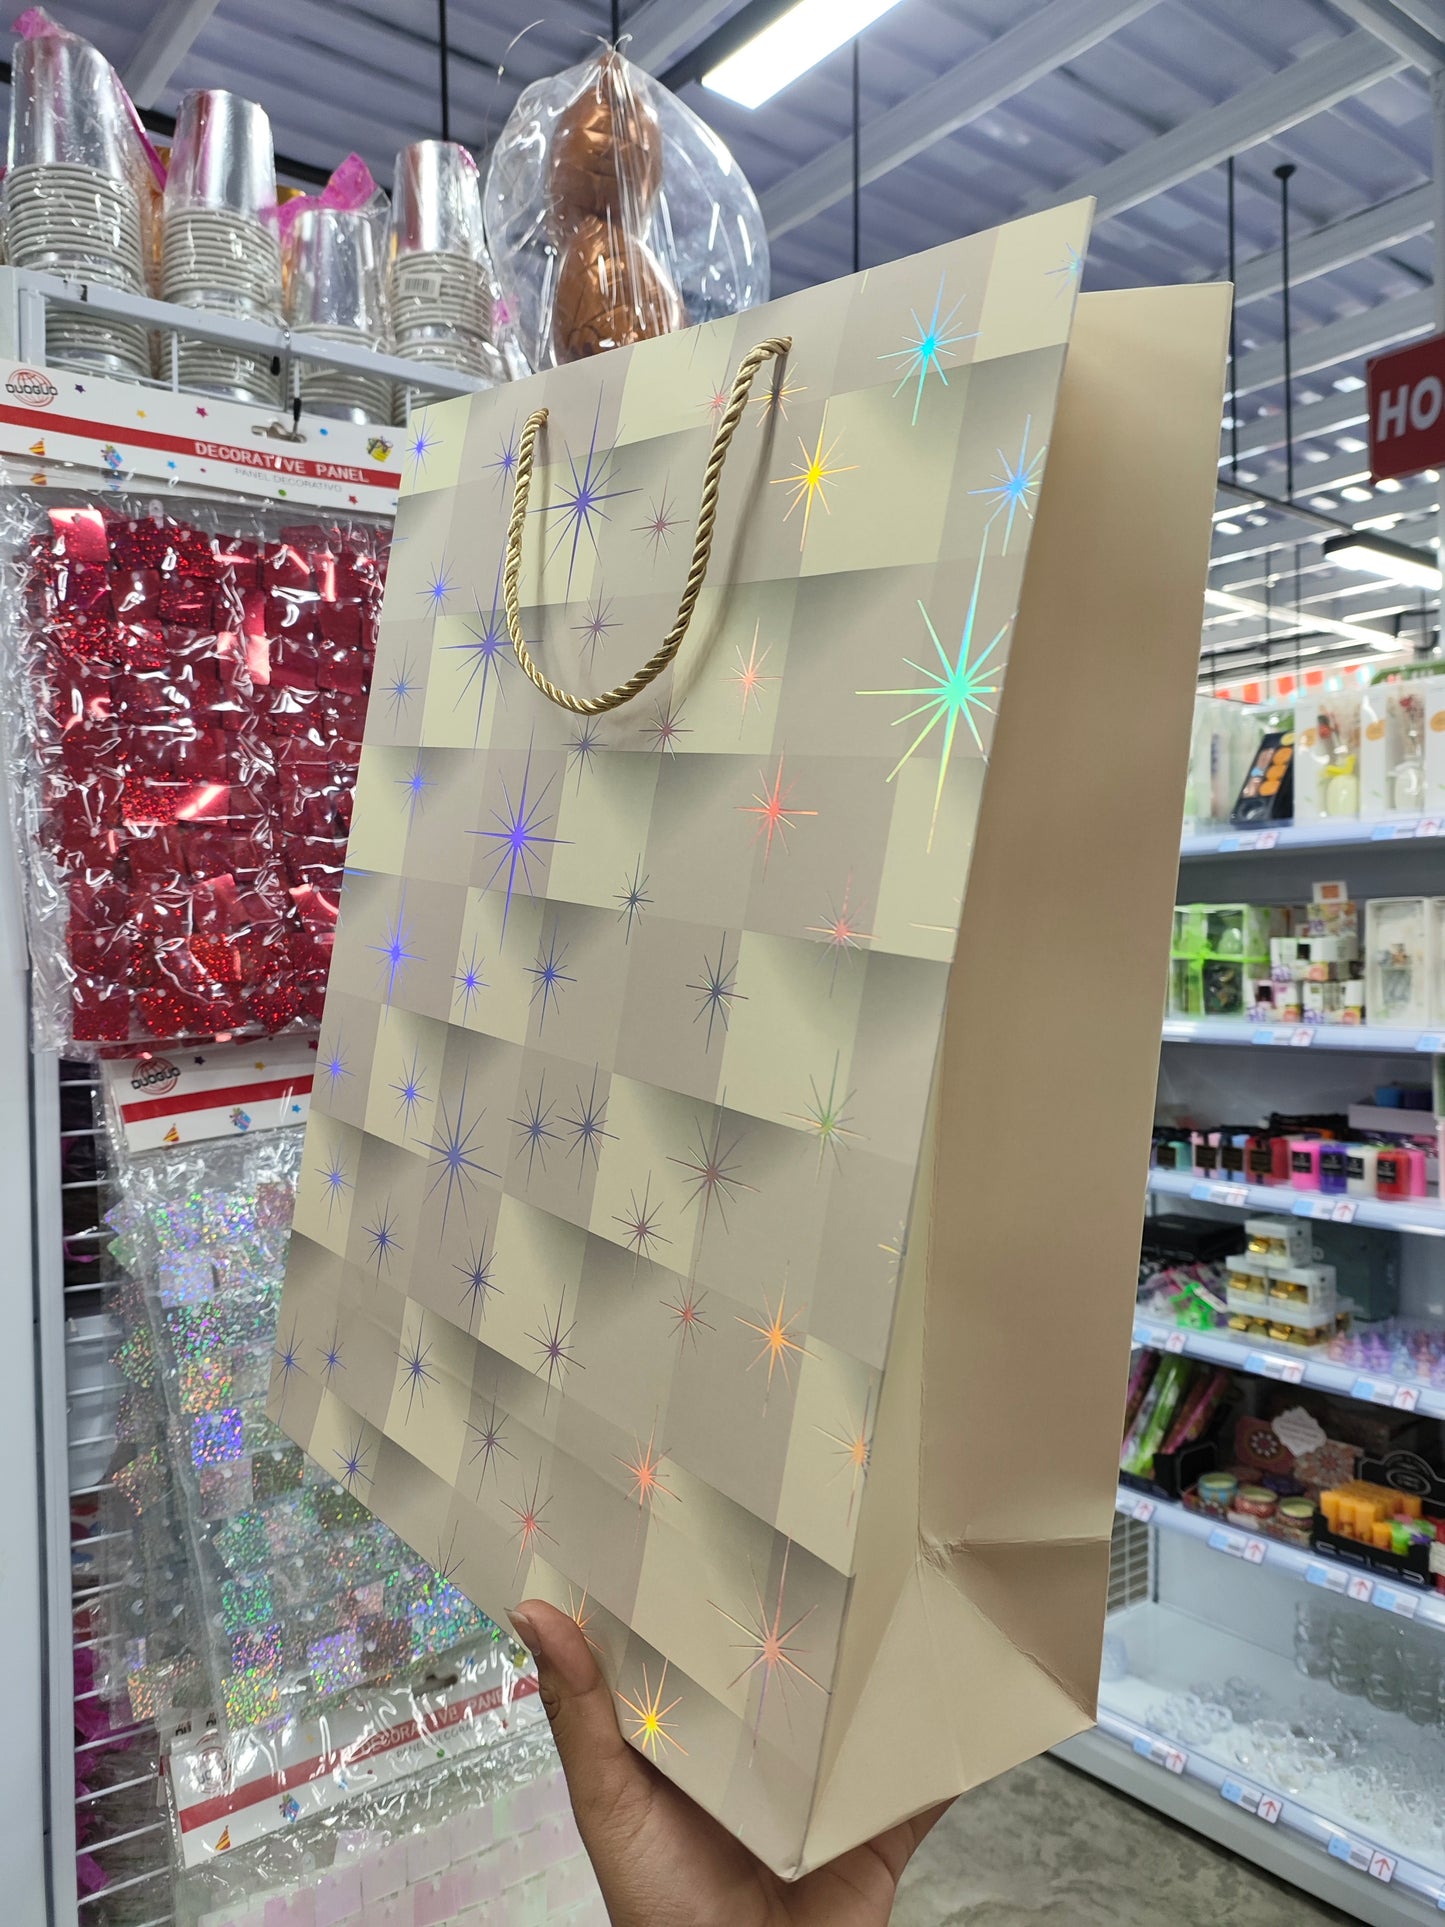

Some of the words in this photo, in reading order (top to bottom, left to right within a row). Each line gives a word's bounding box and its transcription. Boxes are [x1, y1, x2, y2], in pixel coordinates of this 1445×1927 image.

[5, 383, 58, 396] DUOGUO
[1376, 375, 1445, 442] HO
[194, 441, 306, 475] DECORATIVE
[316, 463, 369, 483] PANEL
[235, 467, 271, 482] PANEL
[273, 474, 342, 492] DECORATIVO
[361, 1709, 458, 1753] DECORAVE
[467, 1689, 511, 1714] PANE
